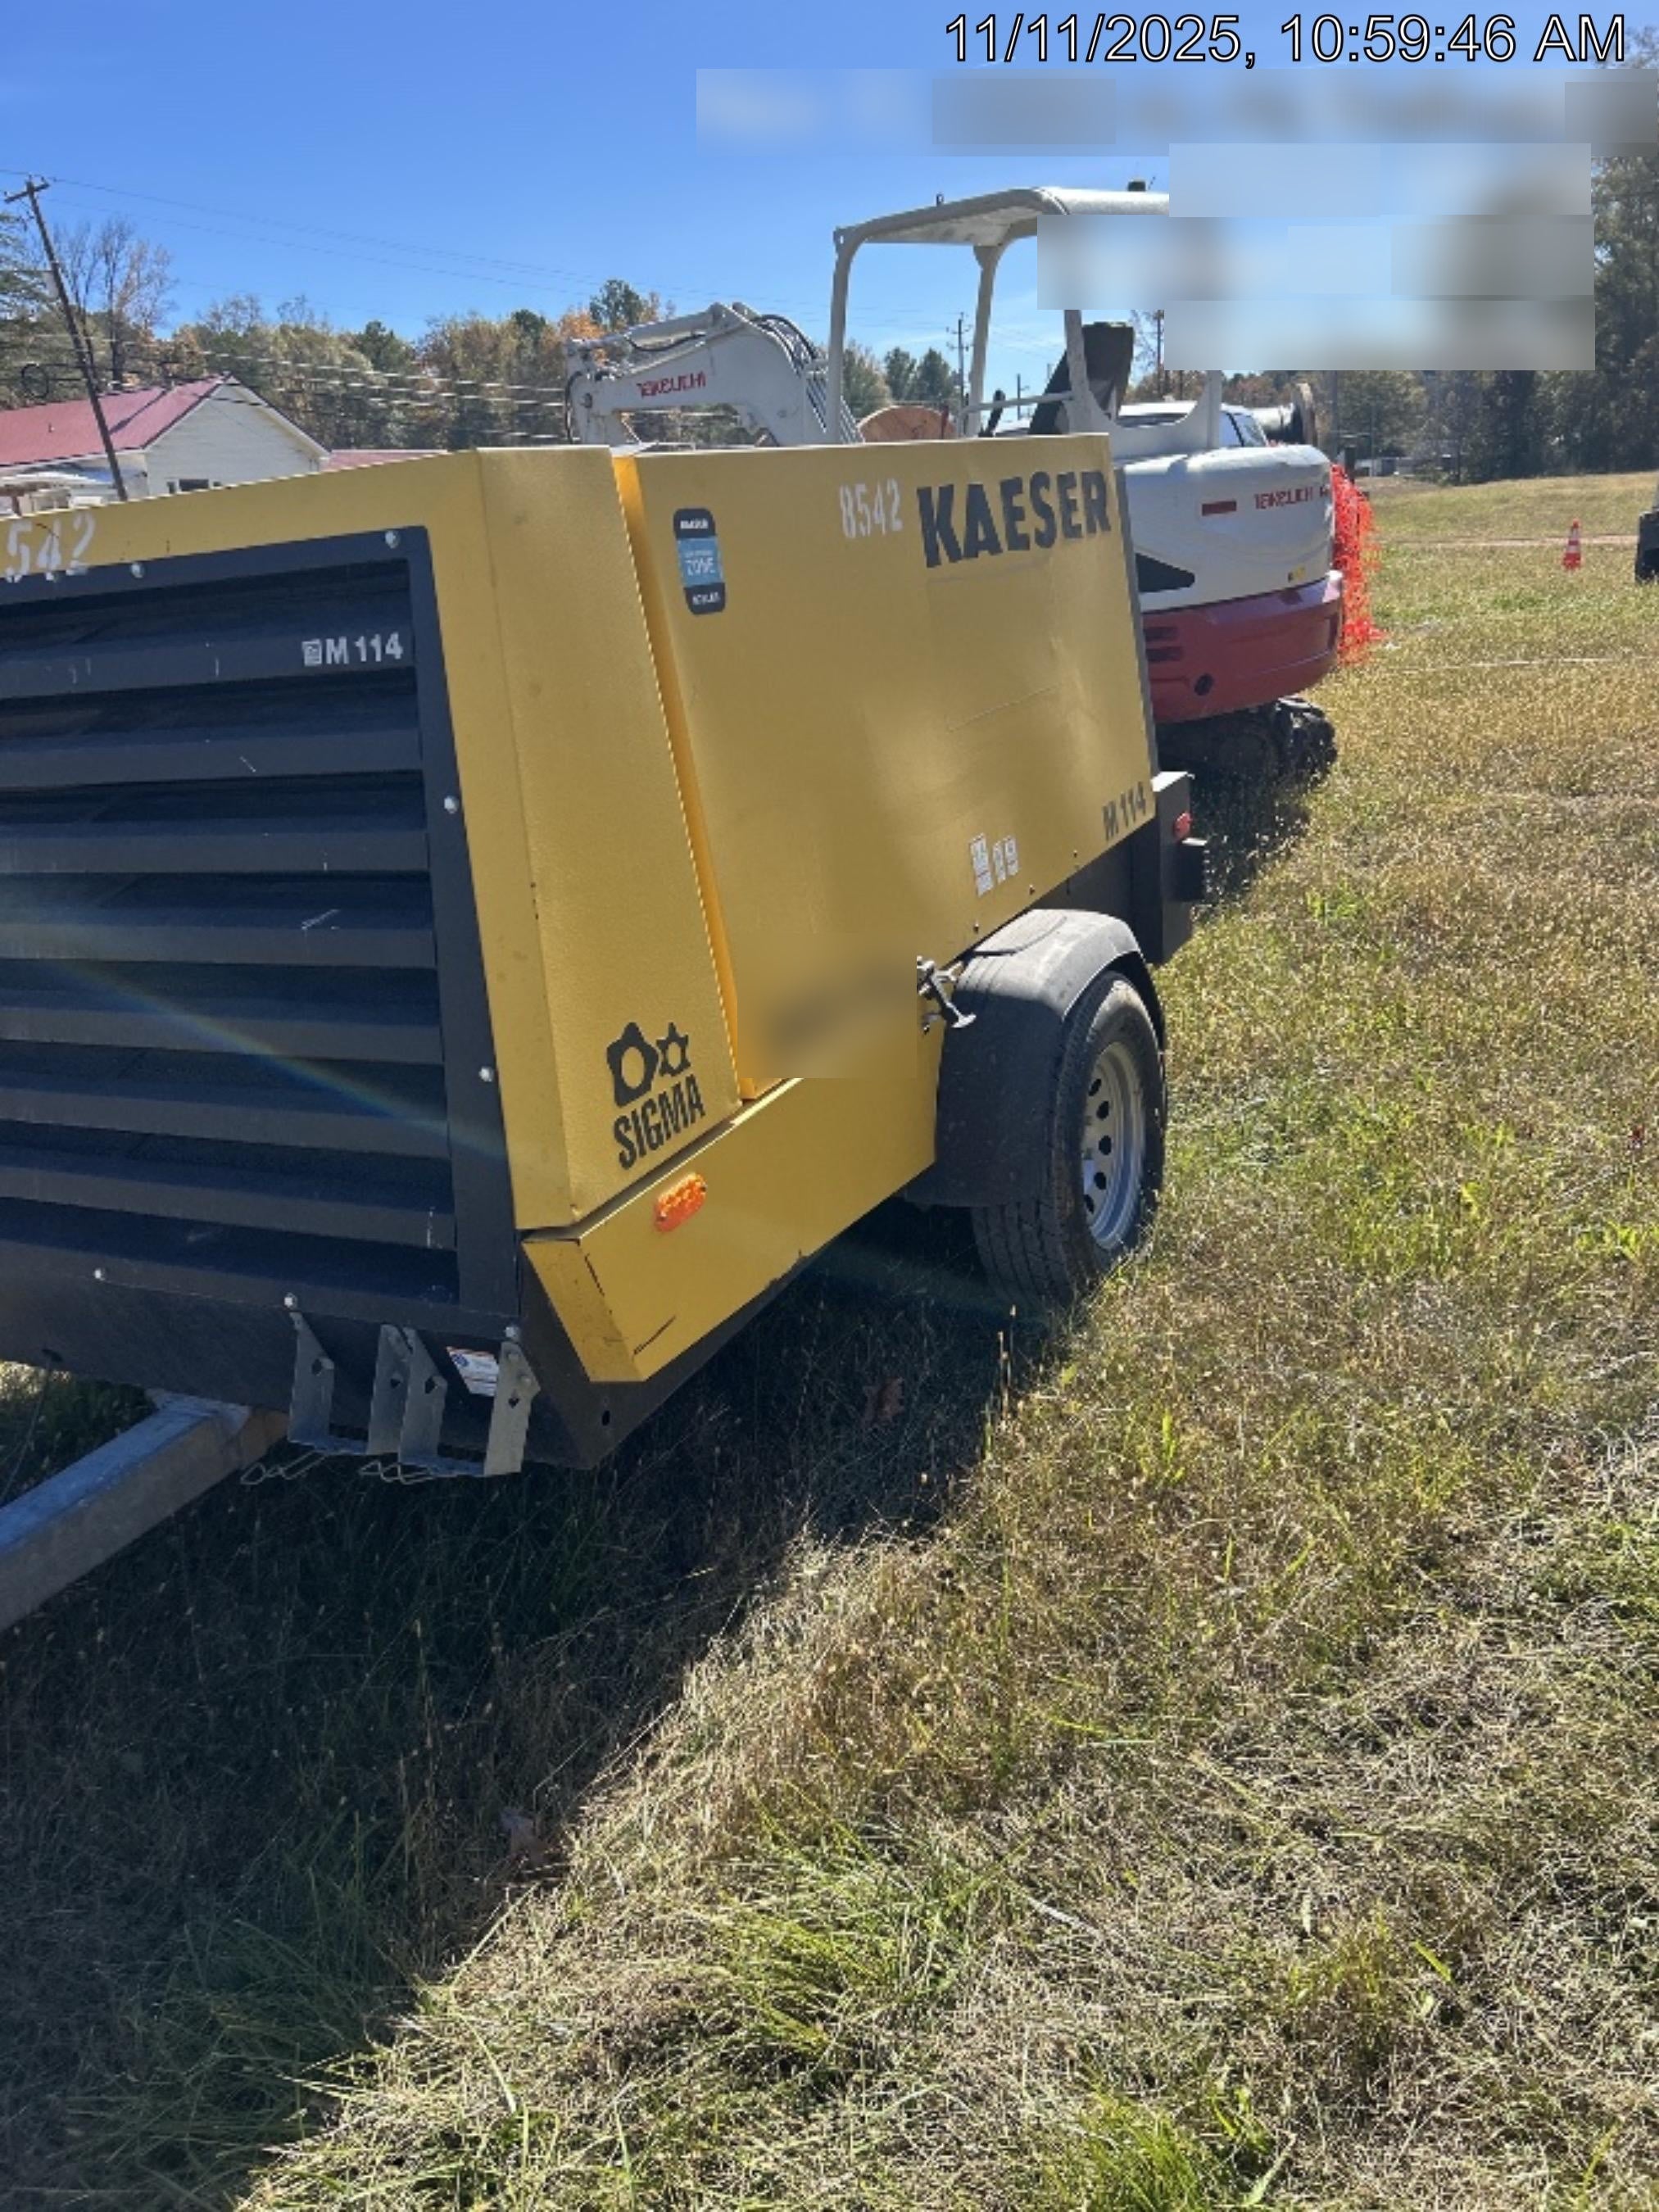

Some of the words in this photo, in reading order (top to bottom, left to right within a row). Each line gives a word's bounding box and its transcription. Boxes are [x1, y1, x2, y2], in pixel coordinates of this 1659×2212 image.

[840, 478, 903, 538] 8542
[917, 471, 1112, 568] KAESER
[326, 636, 349, 664] M
[355, 632, 403, 662] 114
[1103, 801, 1119, 841] M
[1120, 782, 1146, 827] 114
[614, 1074, 705, 1170] SIGMA
